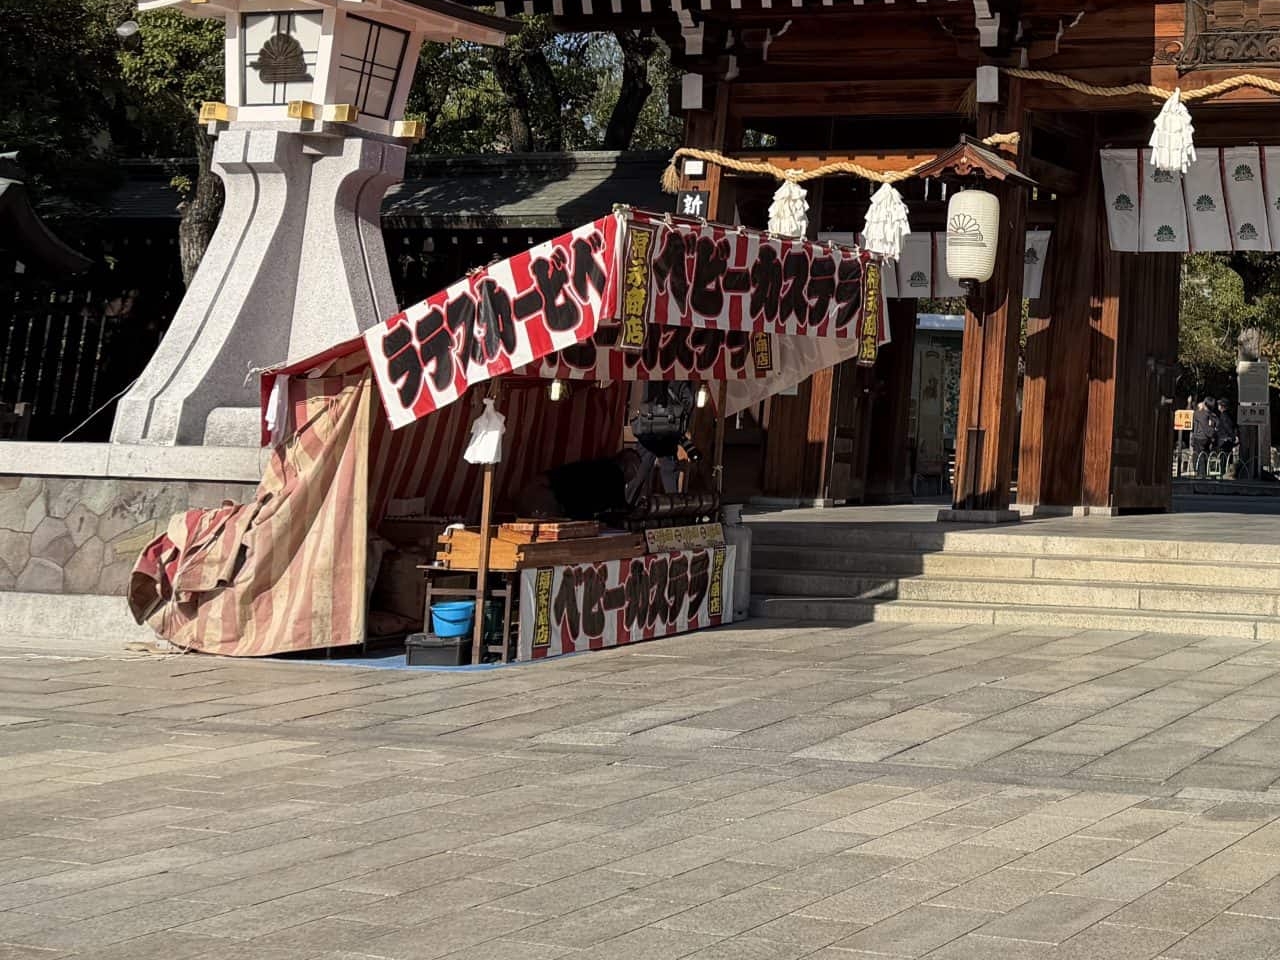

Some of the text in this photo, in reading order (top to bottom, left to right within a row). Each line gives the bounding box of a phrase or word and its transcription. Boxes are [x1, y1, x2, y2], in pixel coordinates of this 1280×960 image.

[683, 194, 703, 217] 新
[652, 229, 863, 331] ベビーカステラ
[553, 549, 710, 643] ベビーカステラ
